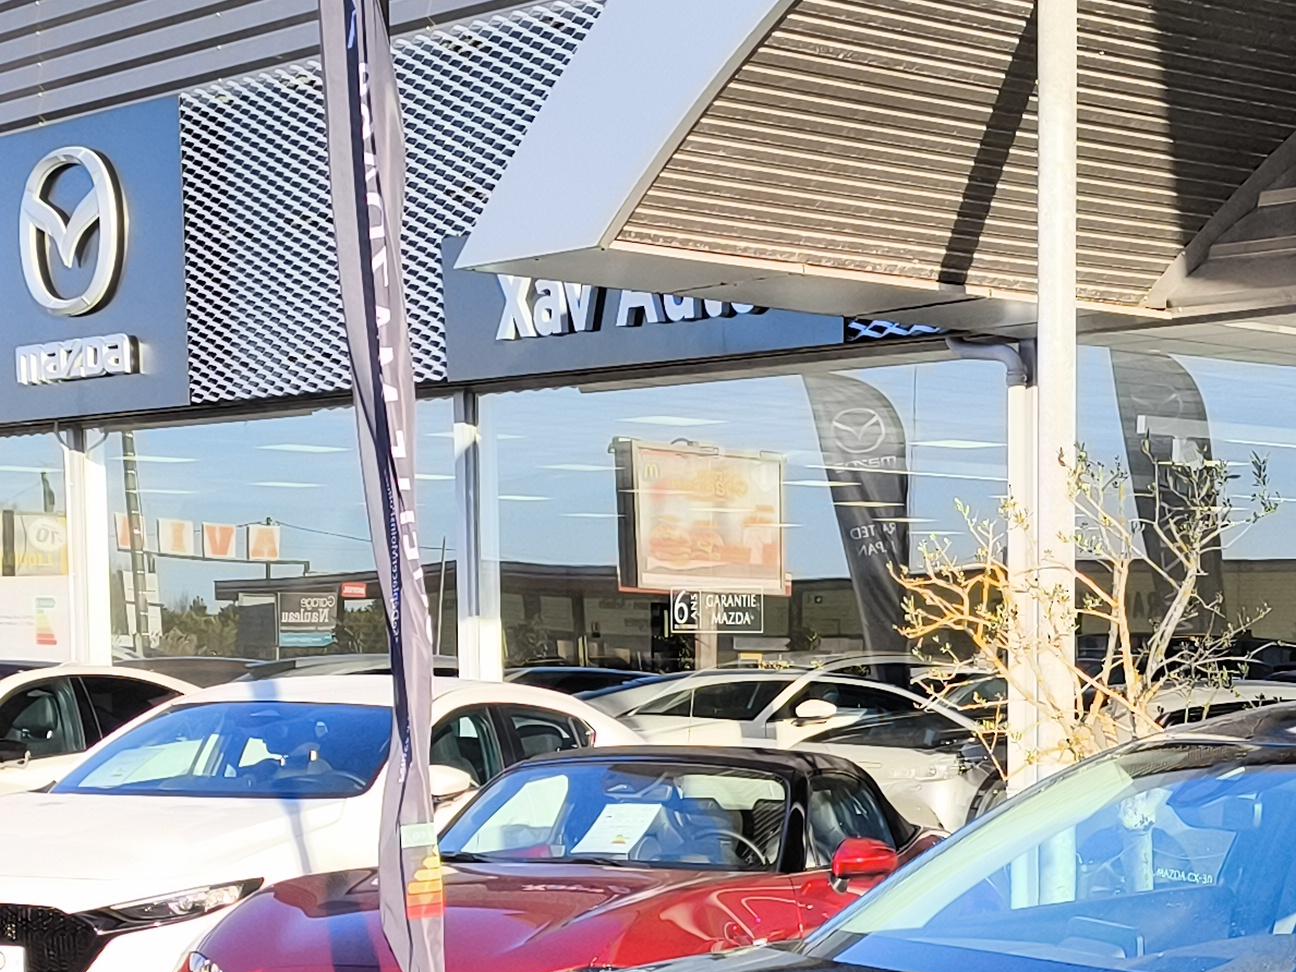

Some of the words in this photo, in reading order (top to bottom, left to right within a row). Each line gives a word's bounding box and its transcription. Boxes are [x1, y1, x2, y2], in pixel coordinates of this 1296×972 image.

[495, 274, 592, 340] Xav
[616, 290, 755, 327] Au
[674, 590, 688, 624] 6
[705, 594, 757, 608] GARANTIE
[711, 612, 751, 625] MAZDA
